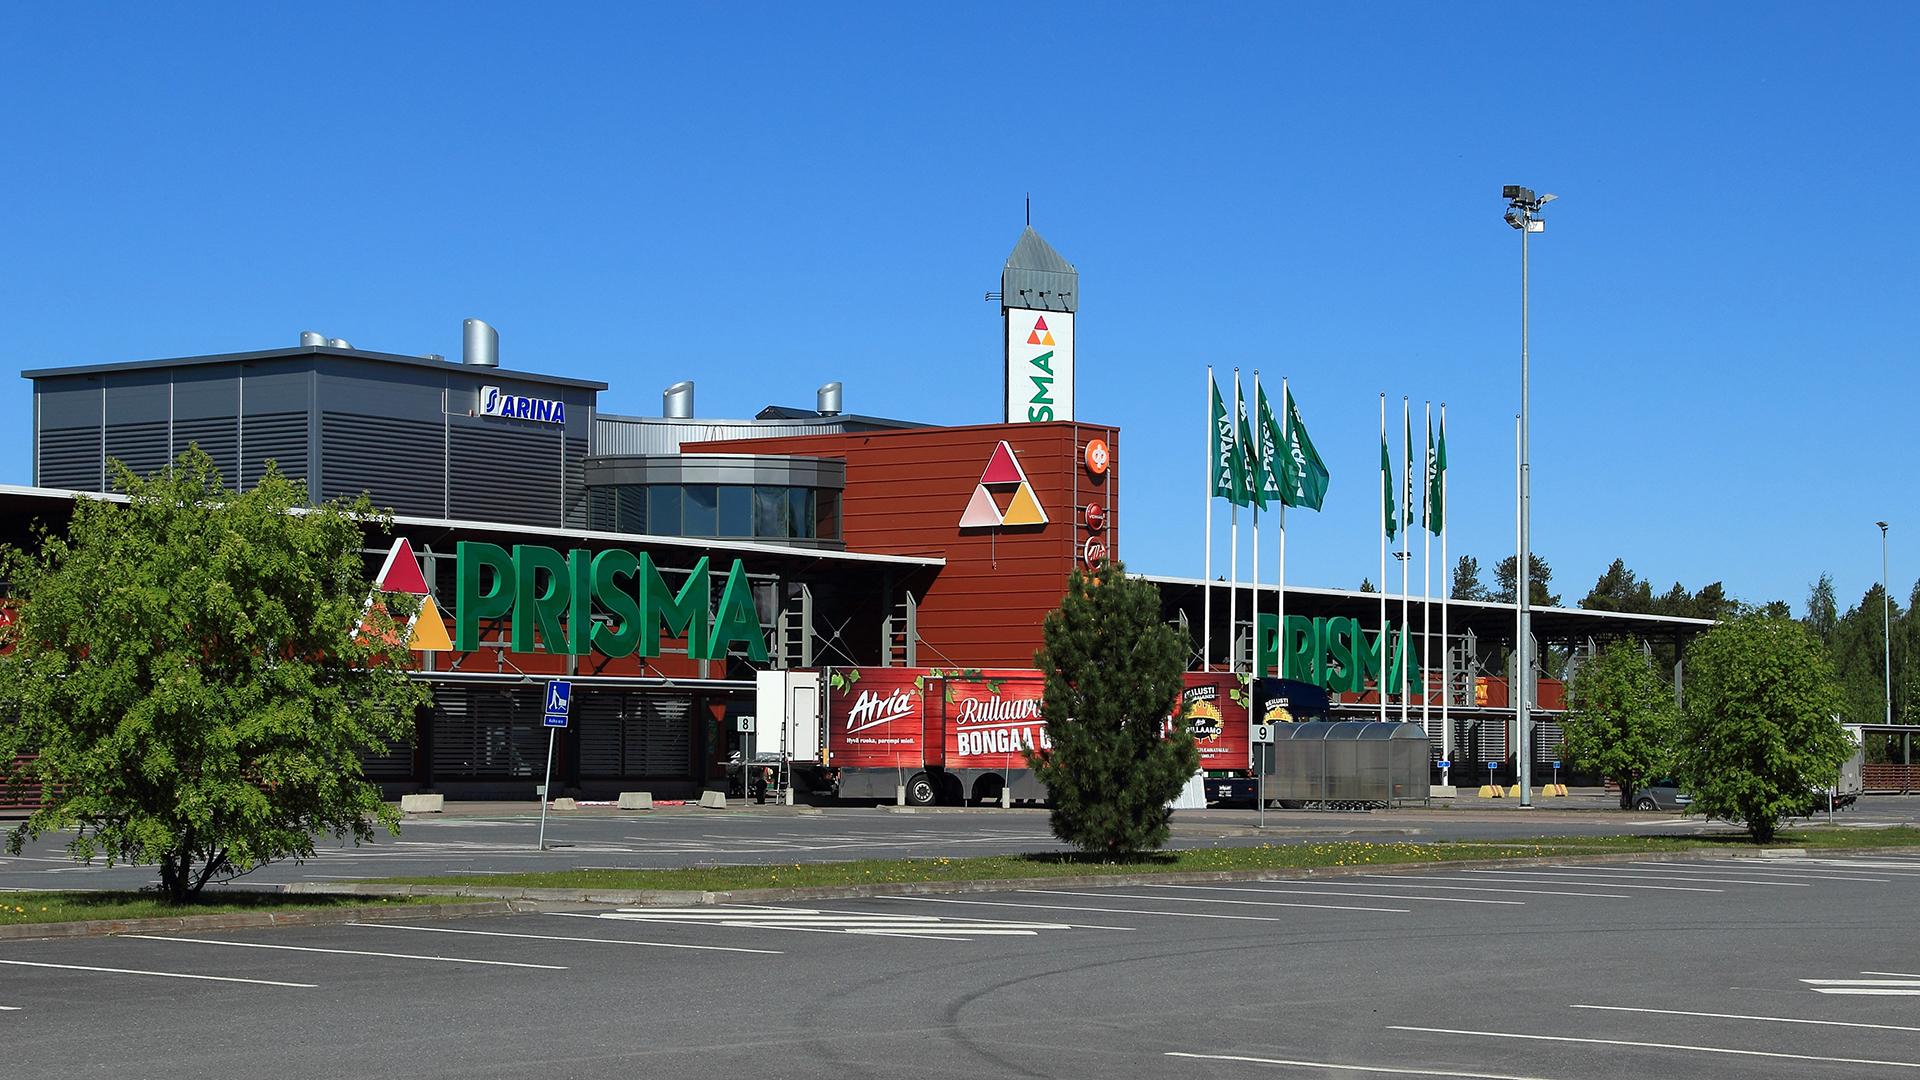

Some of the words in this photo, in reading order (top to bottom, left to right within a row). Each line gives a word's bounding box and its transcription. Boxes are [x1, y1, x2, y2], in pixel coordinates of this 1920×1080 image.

[456, 541, 769, 661] PRISMA
[1257, 613, 1425, 694] PRISMA
[742, 718, 749, 730] 8
[846, 688, 914, 729] Atria
[957, 727, 1035, 756] BONGAA
[1258, 726, 1268, 740] 9
